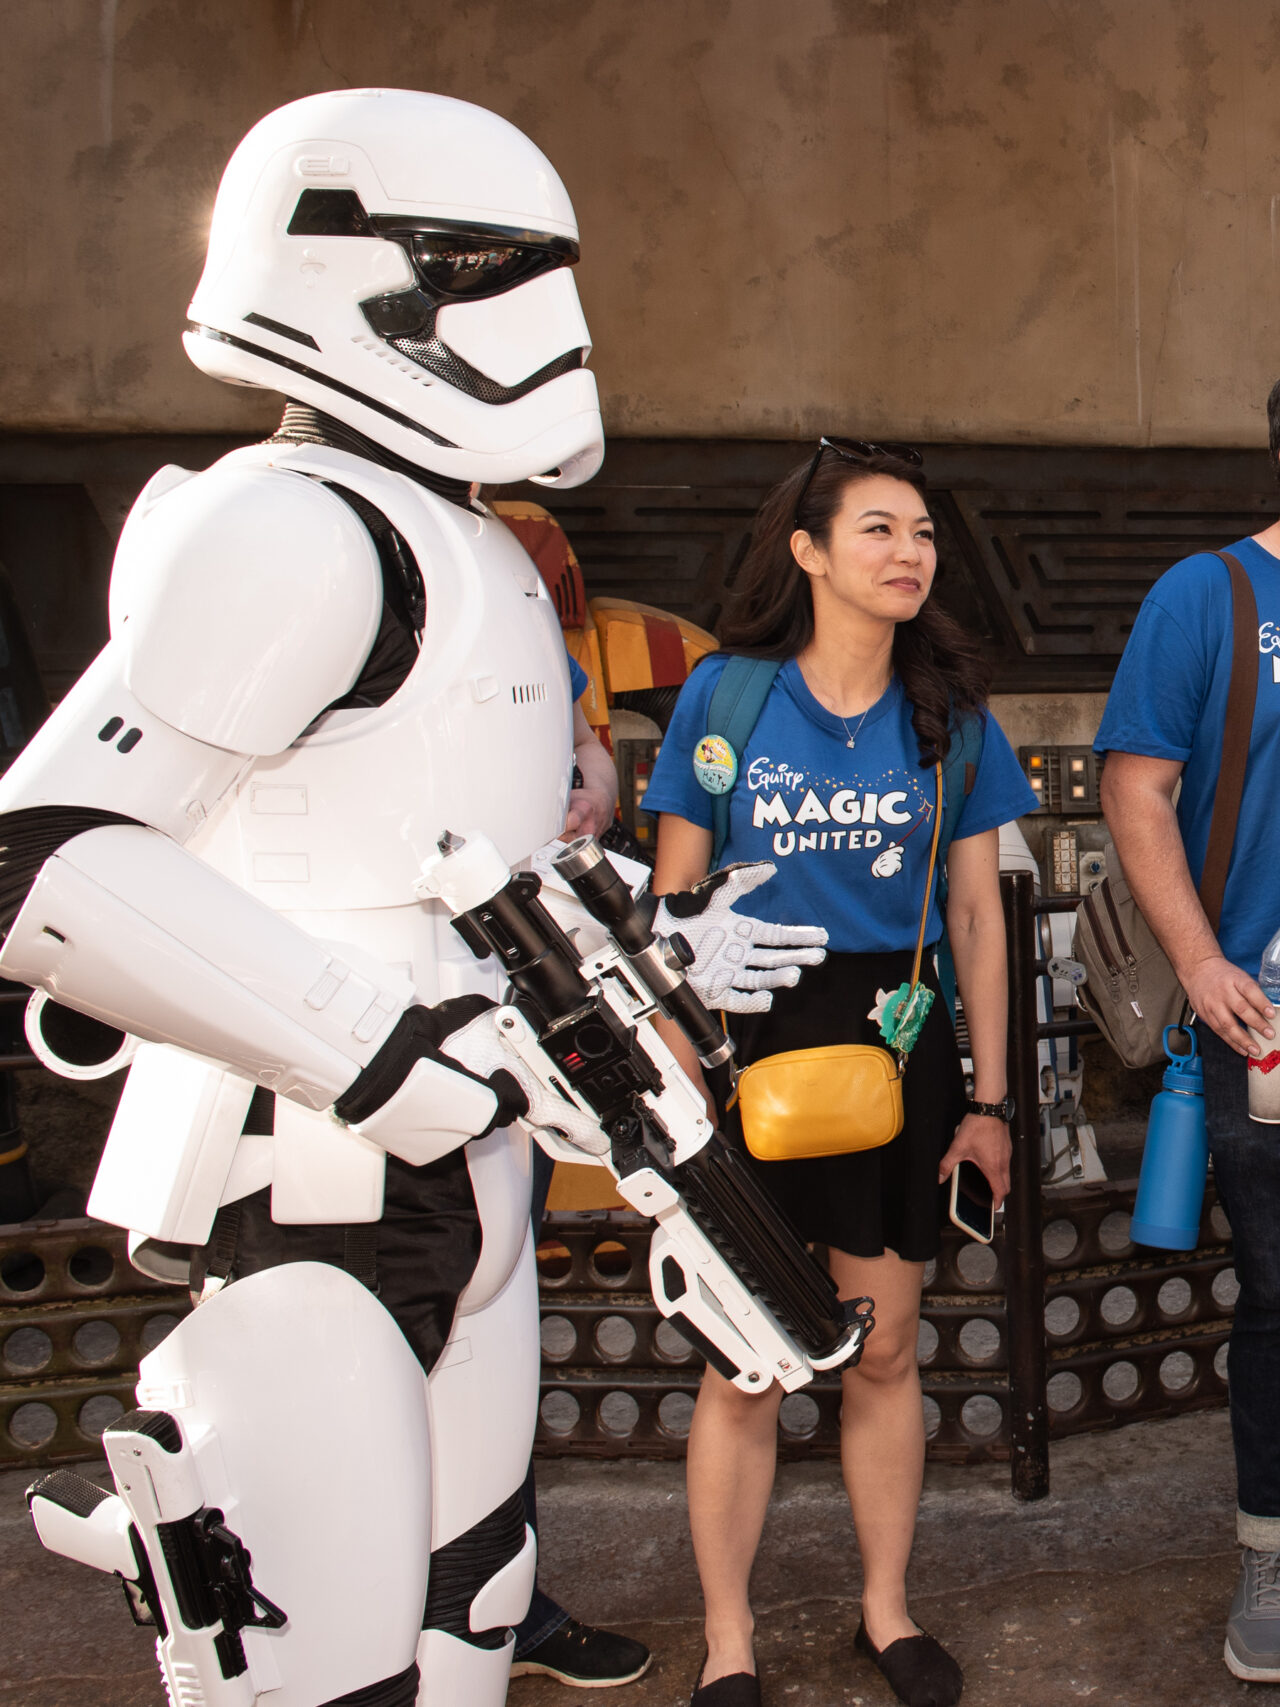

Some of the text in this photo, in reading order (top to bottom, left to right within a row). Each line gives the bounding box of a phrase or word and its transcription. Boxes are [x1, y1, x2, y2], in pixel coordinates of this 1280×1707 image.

[747, 756, 804, 791] Equity
[752, 786, 913, 830] MAGIC
[773, 829, 883, 857] UNITED
